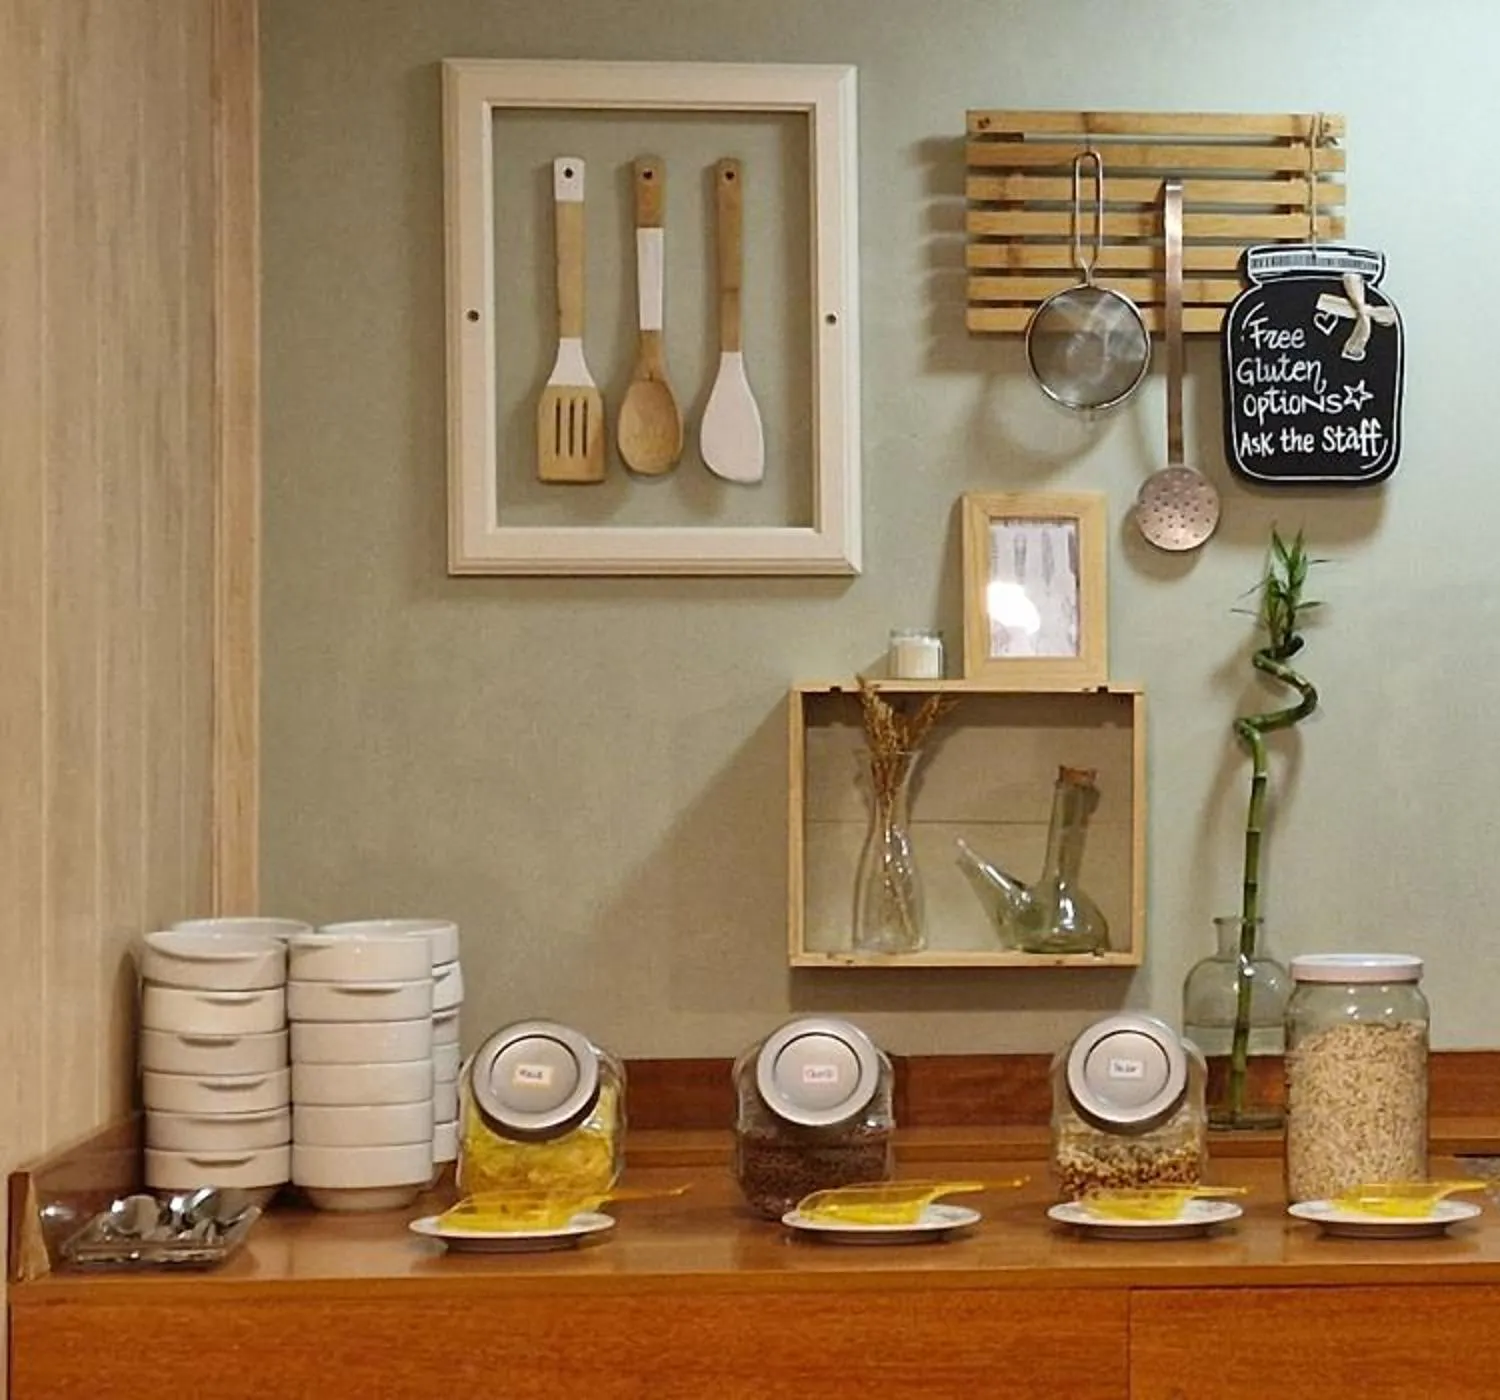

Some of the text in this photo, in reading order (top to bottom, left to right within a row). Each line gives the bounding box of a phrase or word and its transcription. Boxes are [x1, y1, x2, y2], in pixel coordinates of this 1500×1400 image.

[1250, 315, 1305, 350] Free
[1236, 354, 1327, 394] Gluten
[1280, 427, 1314, 453] the
[1321, 417, 1383, 457] Staff
